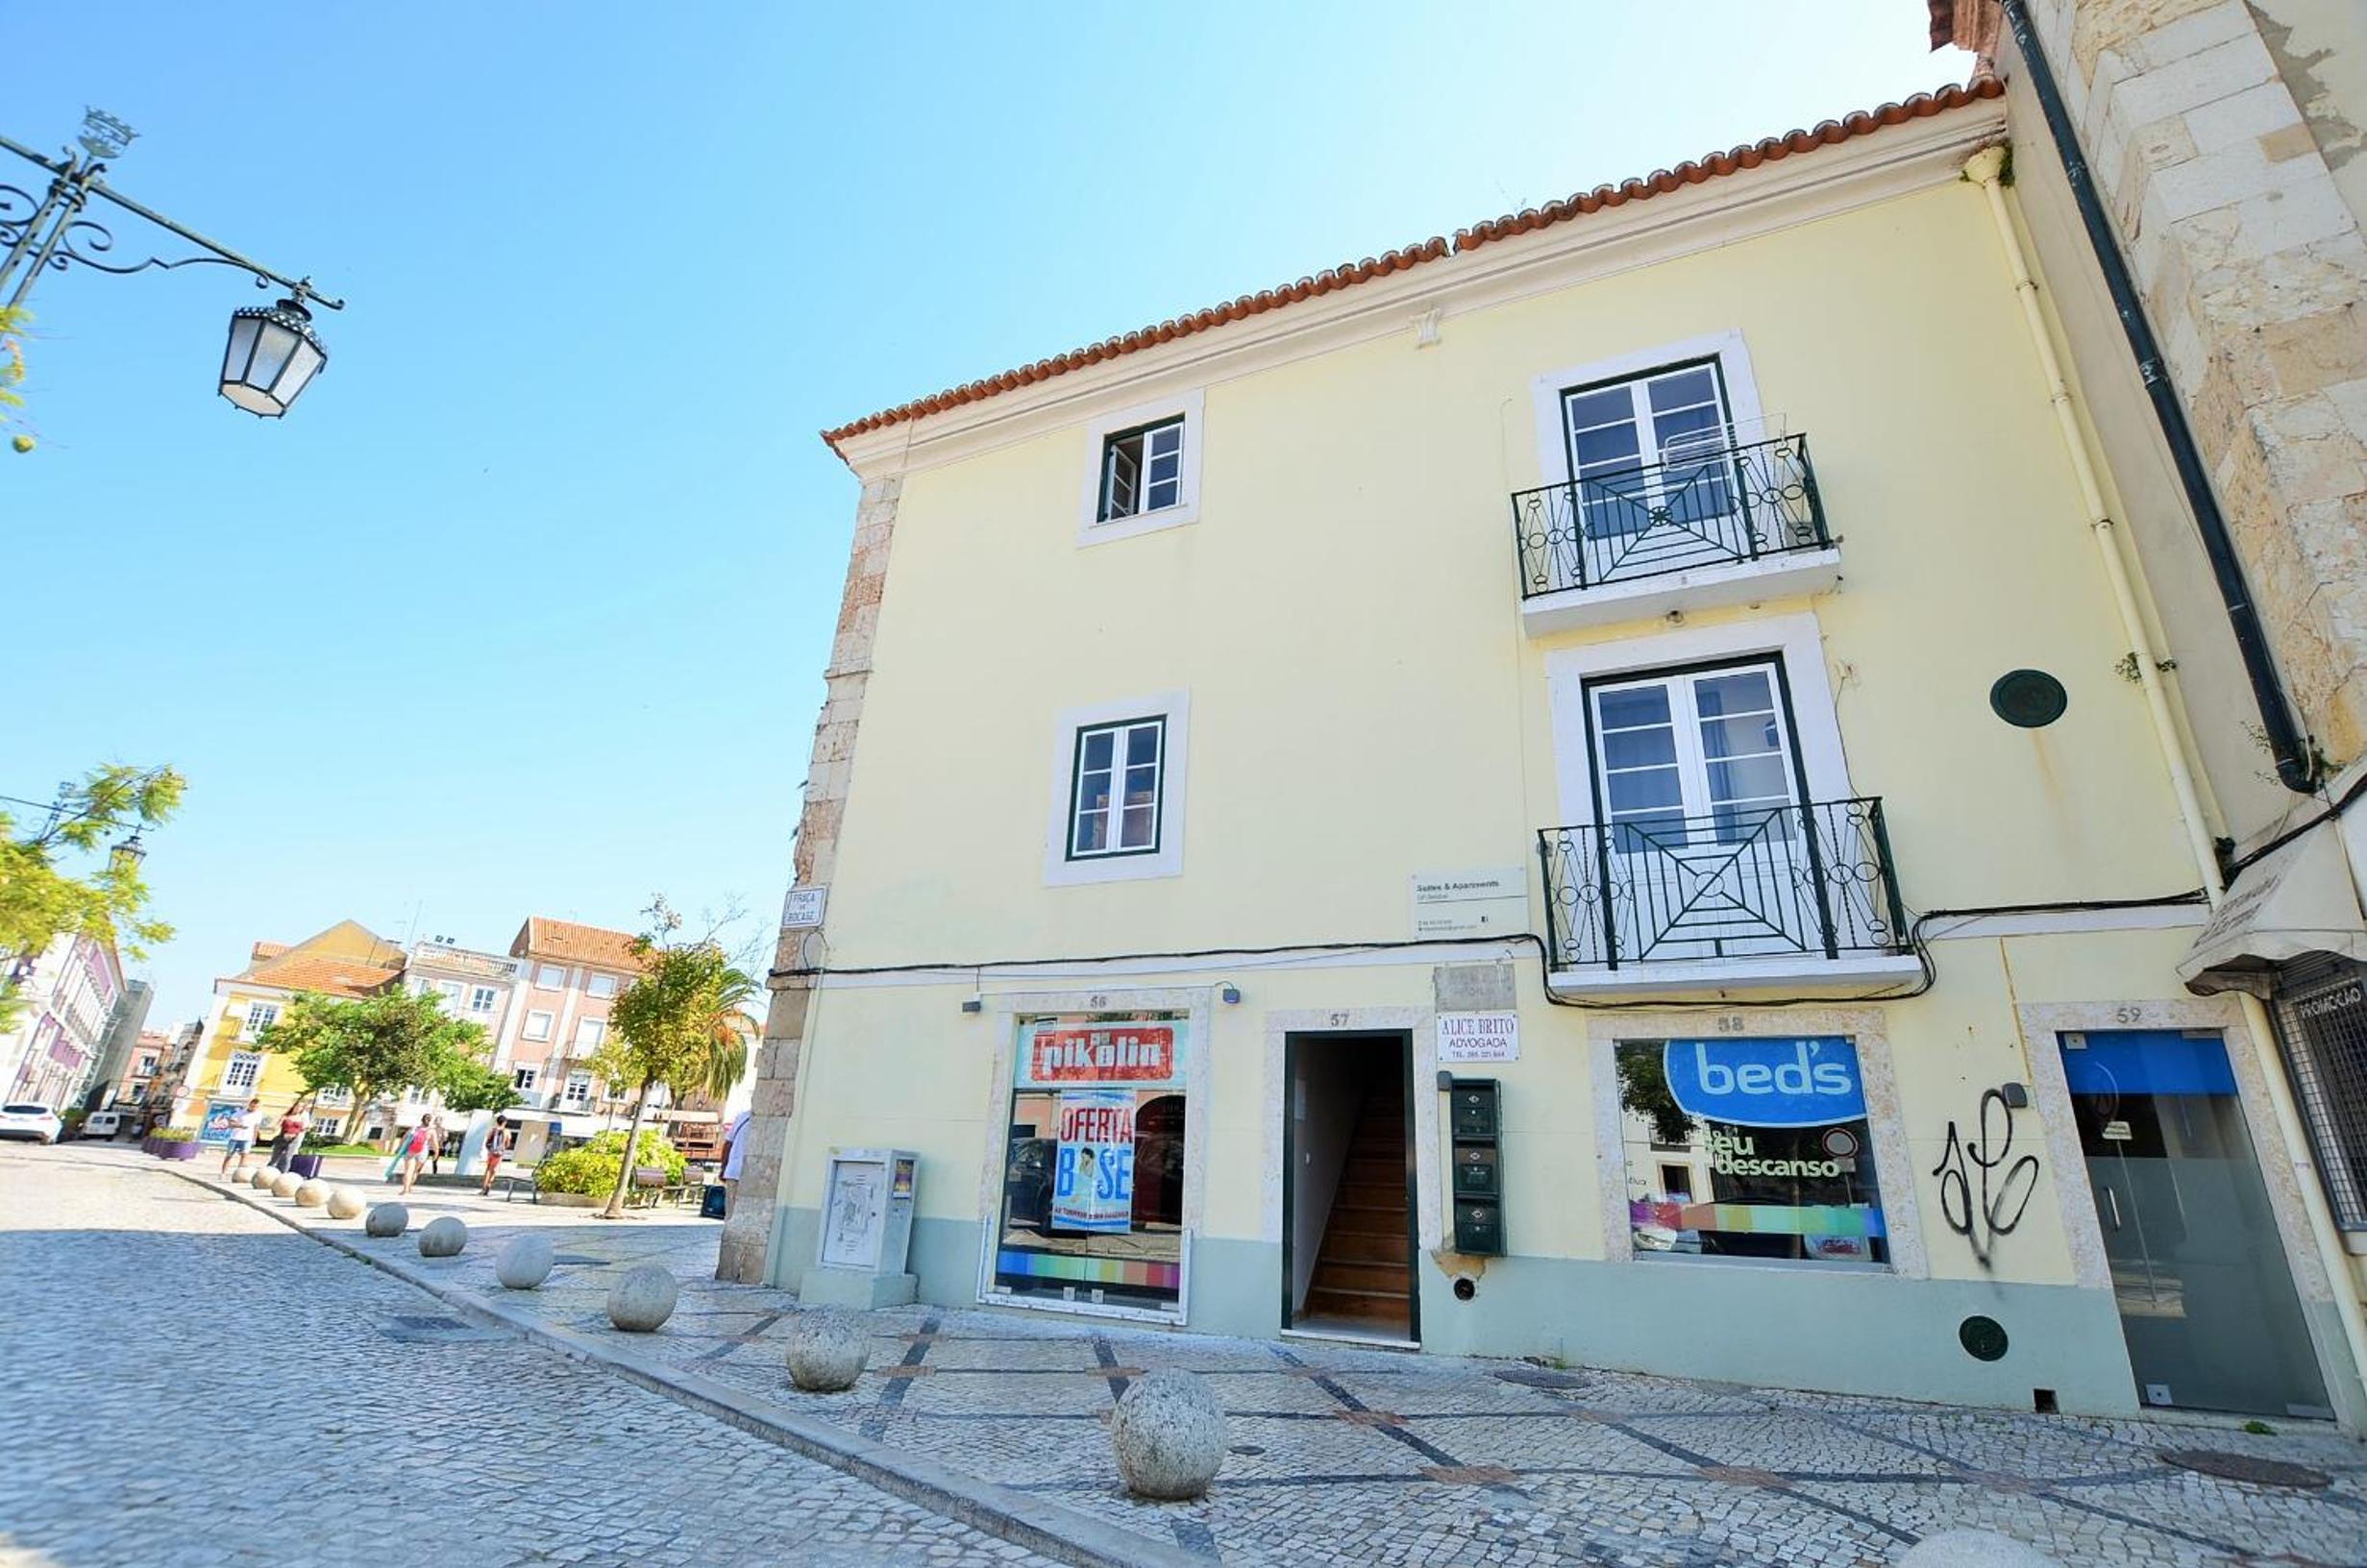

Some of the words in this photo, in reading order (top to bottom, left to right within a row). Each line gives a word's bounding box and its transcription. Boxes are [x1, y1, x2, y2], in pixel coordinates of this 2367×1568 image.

[1331, 1012, 1350, 1028] 57
[2117, 1007, 2142, 1024] 59
[1442, 1018, 1475, 1036] ALICE
[1478, 1018, 1515, 1035] BRITO
[1717, 1017, 1744, 1032] 58
[1449, 1038, 1508, 1049] ADVOGADA
[1695, 1041, 1853, 1095] bed's
[1060, 1107, 1133, 1143] OFERTA
[1715, 1153, 1841, 1178] descanso
